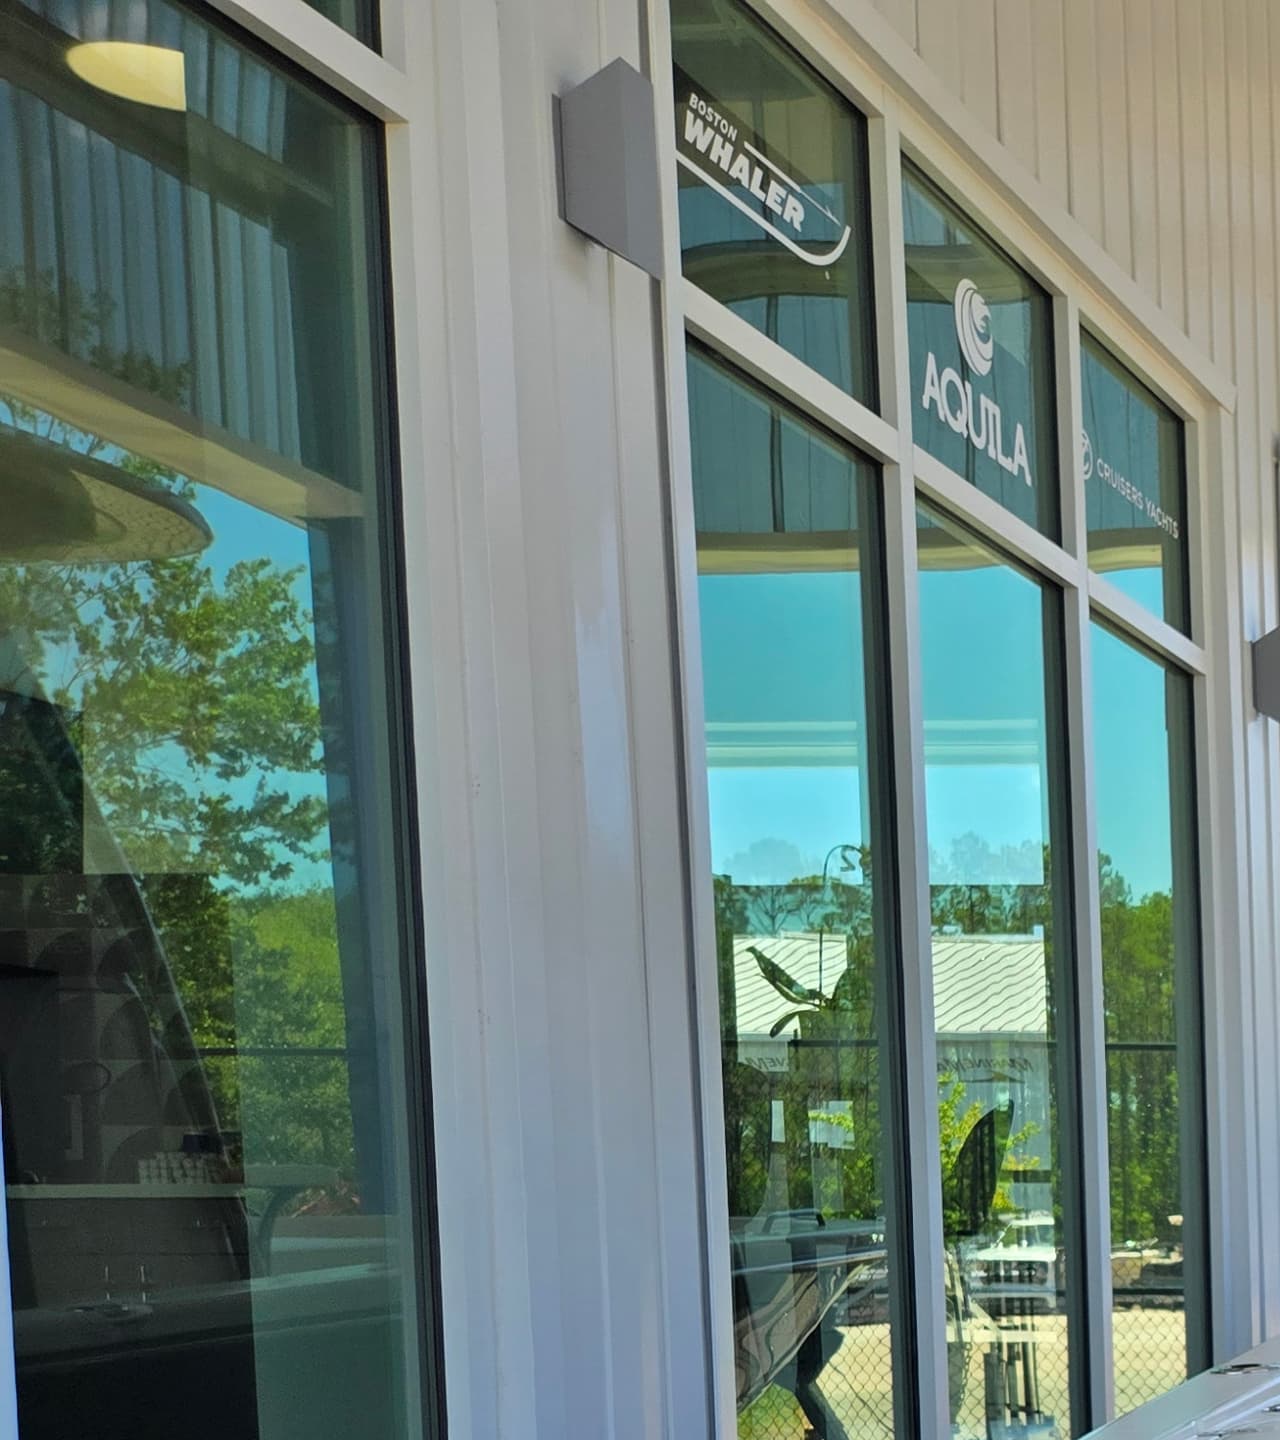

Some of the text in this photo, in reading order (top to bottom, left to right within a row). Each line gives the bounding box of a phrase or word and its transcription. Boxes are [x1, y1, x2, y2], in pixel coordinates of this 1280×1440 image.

[688, 92, 739, 142] BOSTON
[684, 109, 806, 233] WHALER
[922, 351, 1032, 487] AQUILA
[1096, 458, 1179, 539] CRUISERS YACHTS
